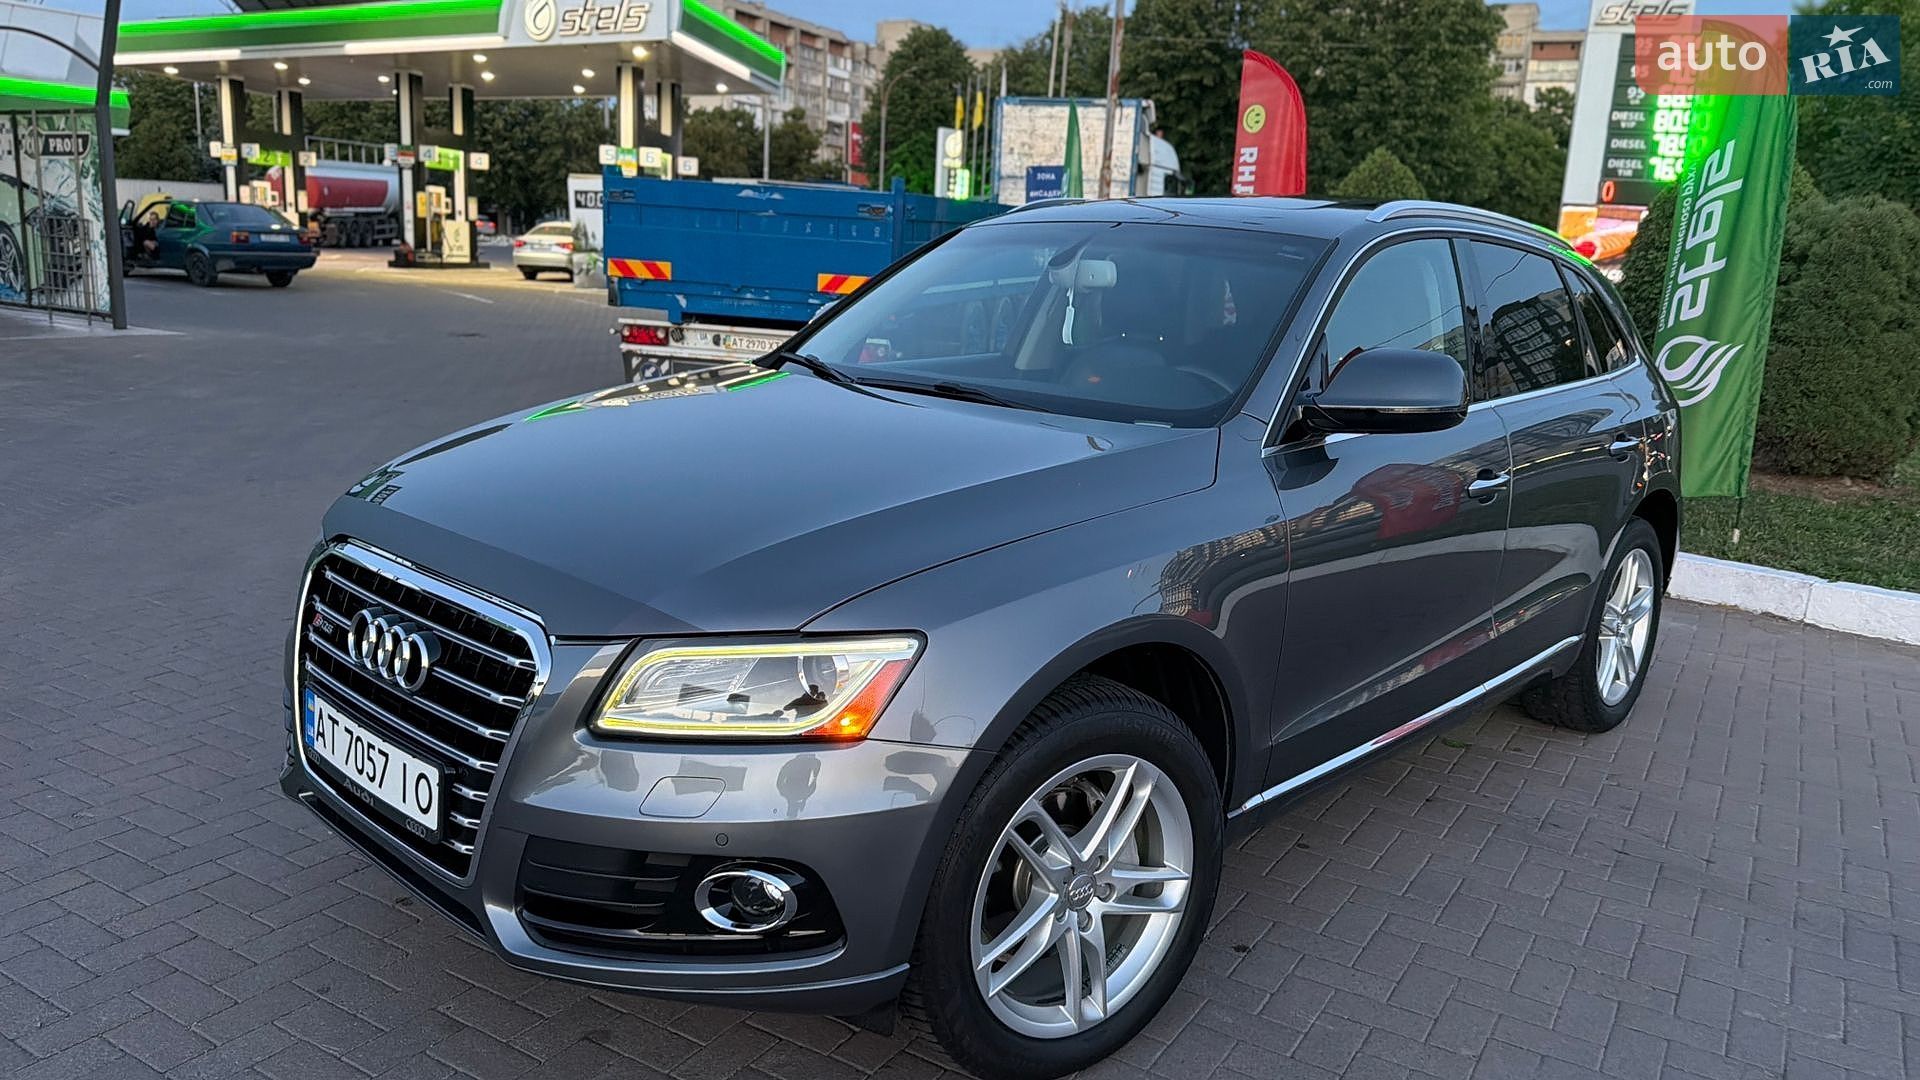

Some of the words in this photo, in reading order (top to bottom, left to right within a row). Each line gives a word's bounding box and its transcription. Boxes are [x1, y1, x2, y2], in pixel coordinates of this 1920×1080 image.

[559, 0, 650, 37] stels
[1611, 111, 1646, 122] DIESEL
[48, 137, 84, 153] PROI
[1610, 139, 1646, 150] DIESEL
[423, 148, 432, 159] 4
[605, 148, 615, 161] 5
[645, 151, 655, 163] 6
[682, 160, 692, 172] 6
[1607, 159, 1643, 169] DIESEL
[731, 336, 743, 347] AT
[746, 337, 766, 350] 2970
[316, 707, 339, 756] AT
[344, 726, 389, 789] 7057
